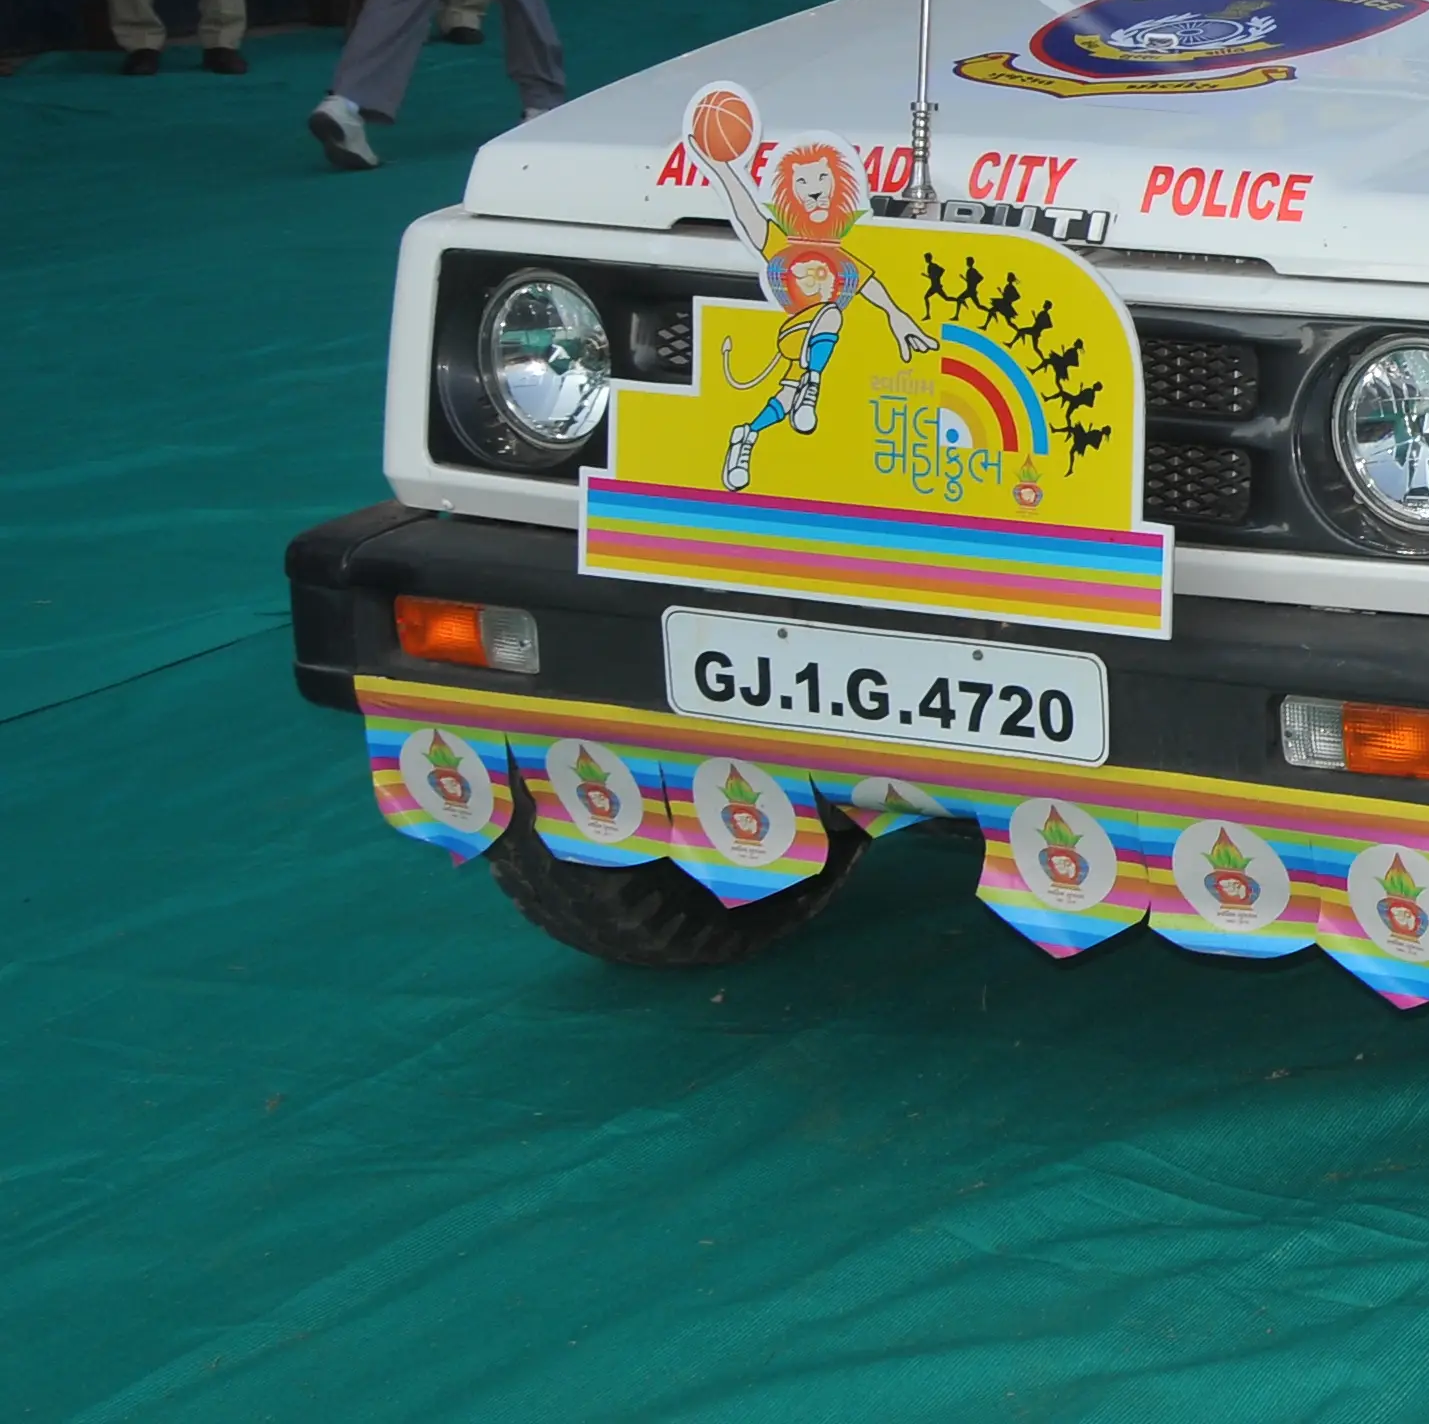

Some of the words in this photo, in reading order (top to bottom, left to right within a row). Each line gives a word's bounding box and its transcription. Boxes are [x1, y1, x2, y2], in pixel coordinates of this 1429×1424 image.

[873, 196, 1109, 243] RUTI
[969, 151, 1078, 205] CITY
[1140, 164, 1315, 223] POLICE
[693, 650, 1075, 744] GJ.1.G.4720
